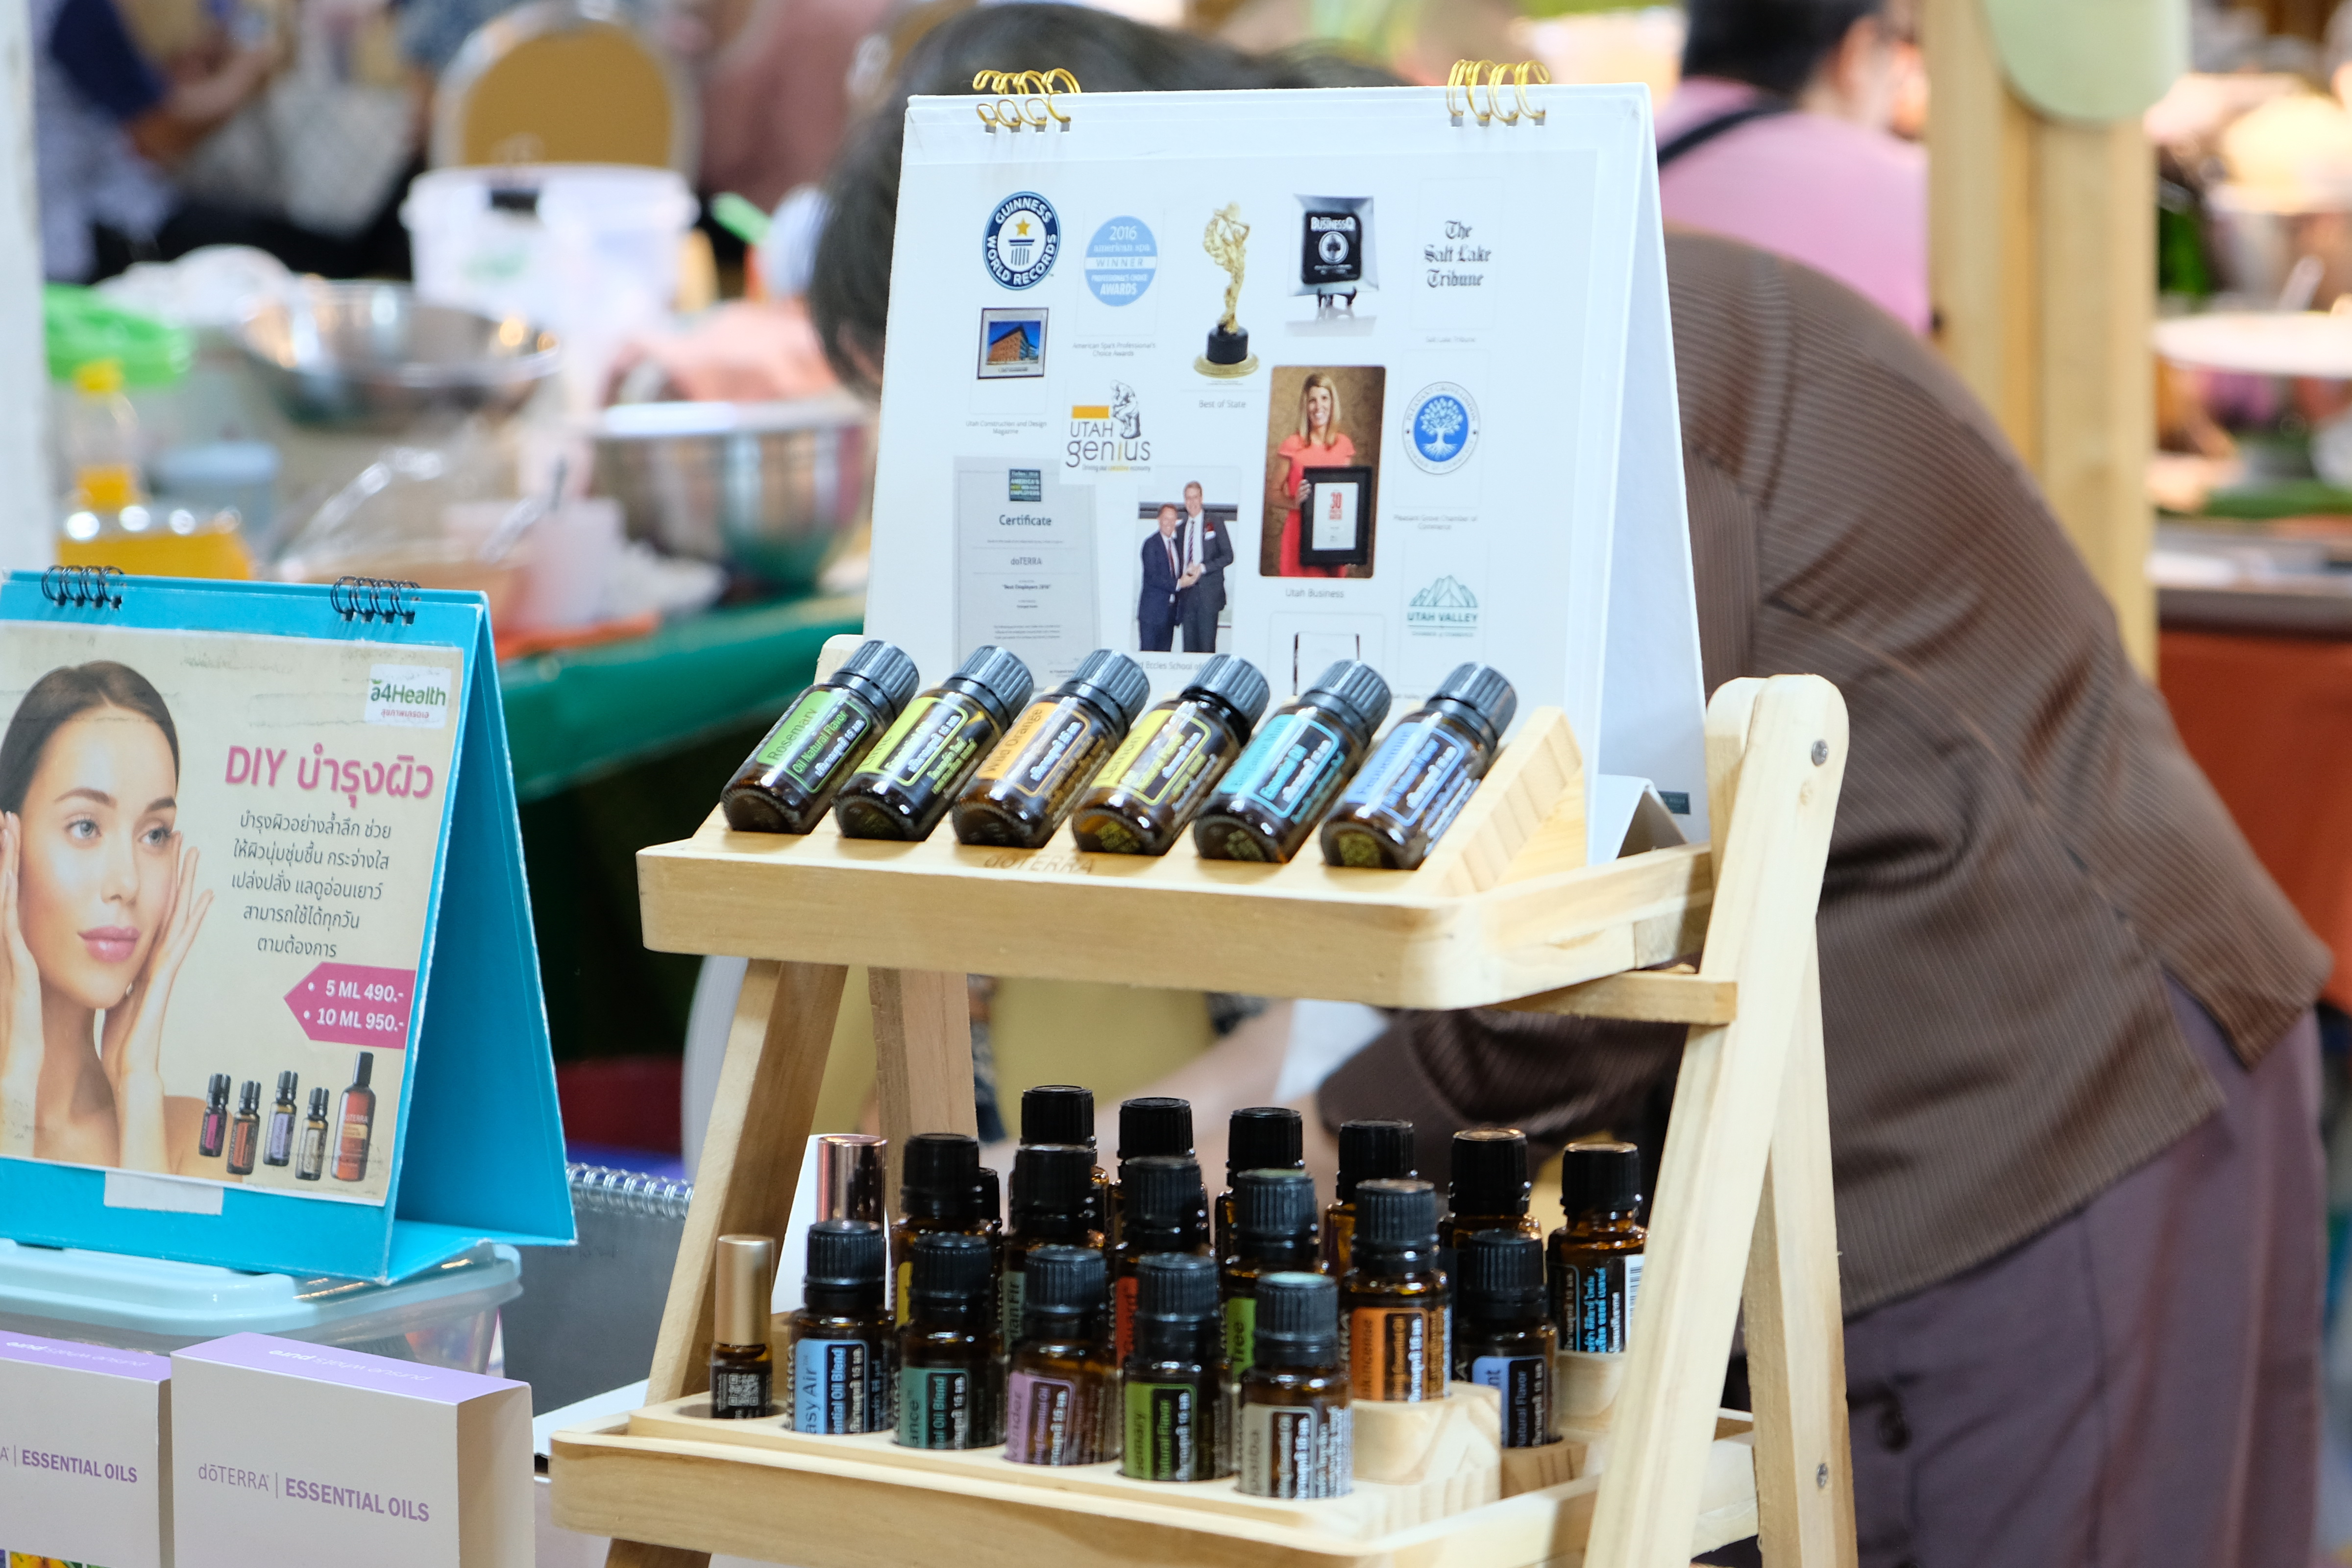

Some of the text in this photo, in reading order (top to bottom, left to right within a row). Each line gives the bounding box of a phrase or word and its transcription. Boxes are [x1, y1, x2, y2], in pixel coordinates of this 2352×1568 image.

[995, 196, 1053, 226] GUINNESS
[1109, 226, 1137, 241] 2016
[1445, 219, 1473, 240] The
[987, 233, 1057, 286] WORLD RECORDS
[1096, 258, 1144, 268] WINNER
[1424, 244, 1492, 263] Salt Lake
[1100, 283, 1137, 295] AWARDS
[1426, 268, 1484, 288] Tribune
[1199, 399, 1247, 408] Best of State
[1070, 420, 1114, 438] UTAH
[1065, 439, 1152, 468] genius
[1330, 492, 1342, 508] 30
[998, 514, 1052, 527] Certificate
[1285, 588, 1344, 598] Utah Business
[1407, 612, 1477, 622] UTAH VALLEY
[766, 707, 818, 764] Rosemary
[791, 759, 808, 775] Oil
[801, 731, 831, 763] Natural
[823, 708, 850, 736] Flavor
[844, 729, 857, 741] 15
[937, 724, 952, 737] 15
[983, 706, 1045, 777] Wild Orange
[1100, 733, 1142, 783] Lemon
[225, 742, 434, 809] DIY บำรุงผิว
[365, 818, 392, 839] ช่วย
[233, 838, 390, 870] ให้ผิวนุ่มชุ่มชื้น กระจ่างใส
[231, 869, 384, 901] เปล่งปลั่ง แลดูอ่อนเยาว์
[243, 904, 360, 932] สามารถใช้ได้ทุกวัน
[257, 933, 338, 958] ตามต้องการ
[325, 979, 404, 1004] 5 ML 490.-
[317, 1007, 405, 1032] 10 ML 950.-
[6, 1341, 49, 1351] pure
[269, 1349, 433, 1381] pursue what's pure
[831, 1347, 846, 1382] Blend
[831, 1383, 846, 1400] Oil
[932, 1376, 946, 1410] Blend
[804, 1400, 821, 1434] asy
[932, 1413, 946, 1428] Oil
[22, 1449, 101, 1477] ESSENTIAL
[104, 1463, 137, 1483] OILS
[286, 1477, 385, 1514] ESSENTIAL
[388, 1497, 429, 1522] OILS
